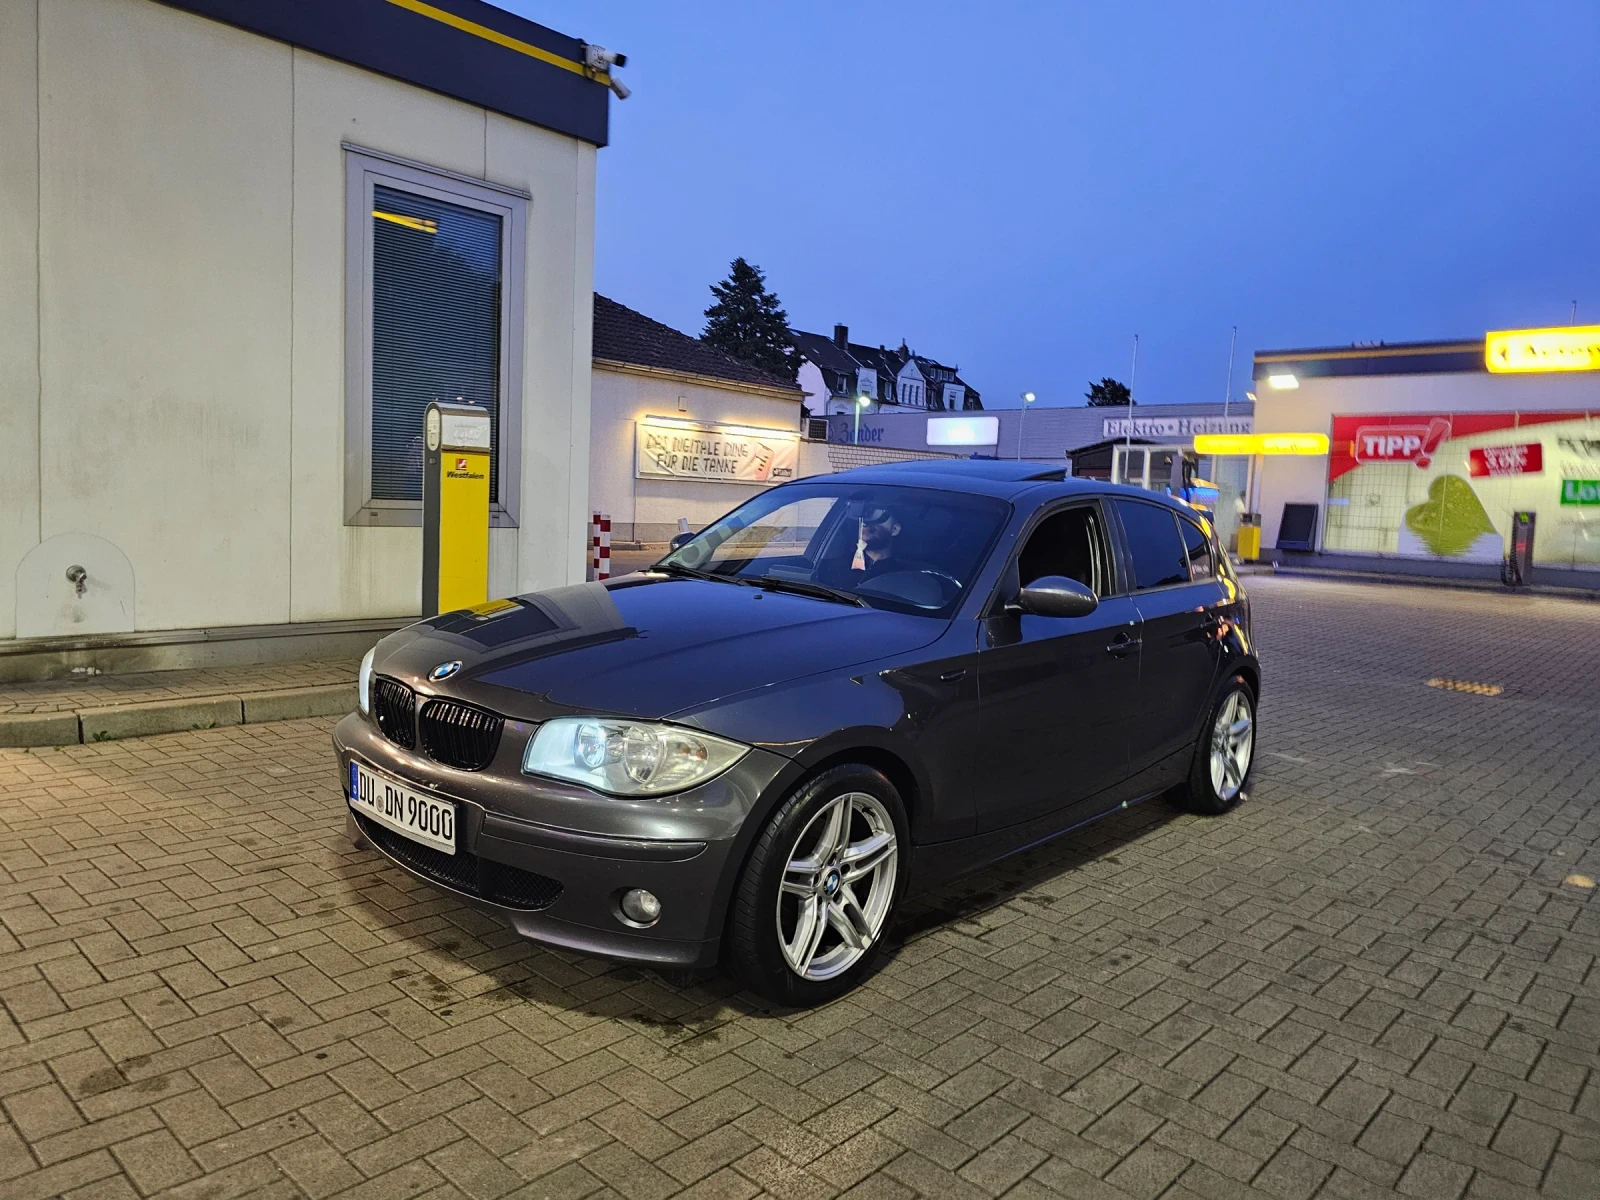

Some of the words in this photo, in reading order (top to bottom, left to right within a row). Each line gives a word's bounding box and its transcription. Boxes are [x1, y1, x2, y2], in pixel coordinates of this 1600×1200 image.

[1107, 420, 1165, 436] Elektro
[1178, 417, 1252, 434] Heizung
[656, 450, 677, 469] FÜR
[681, 456, 700, 472] DIE
[703, 456, 738, 474] TANKE
[446, 471, 483, 480] Westfalen
[359, 771, 375, 807] DU
[385, 784, 404, 822] DN
[408, 796, 453, 841] 9000
